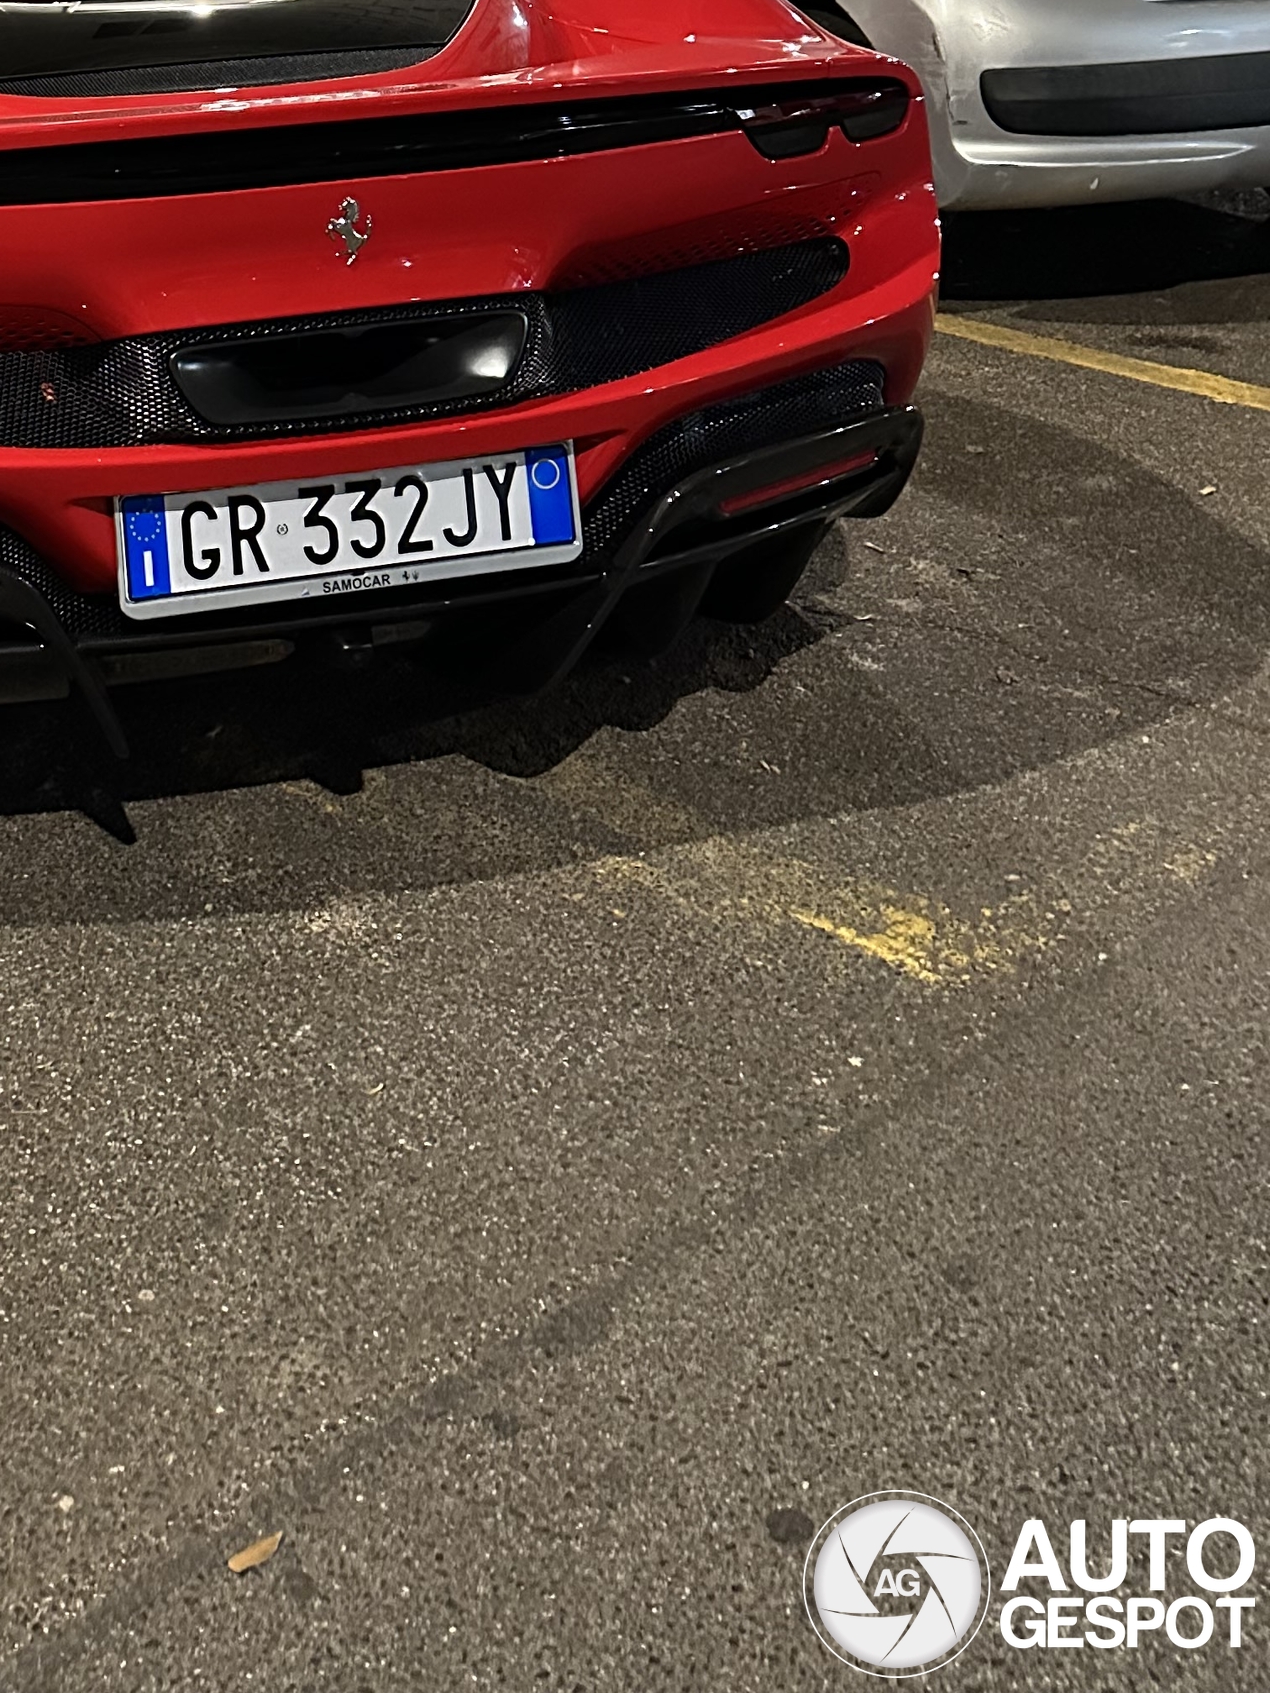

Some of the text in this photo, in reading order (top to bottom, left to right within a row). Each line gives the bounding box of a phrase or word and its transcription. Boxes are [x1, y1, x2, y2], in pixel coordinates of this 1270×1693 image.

[180, 461, 518, 582] GR 332JY
[322, 573, 391, 594] SAMOCAR
